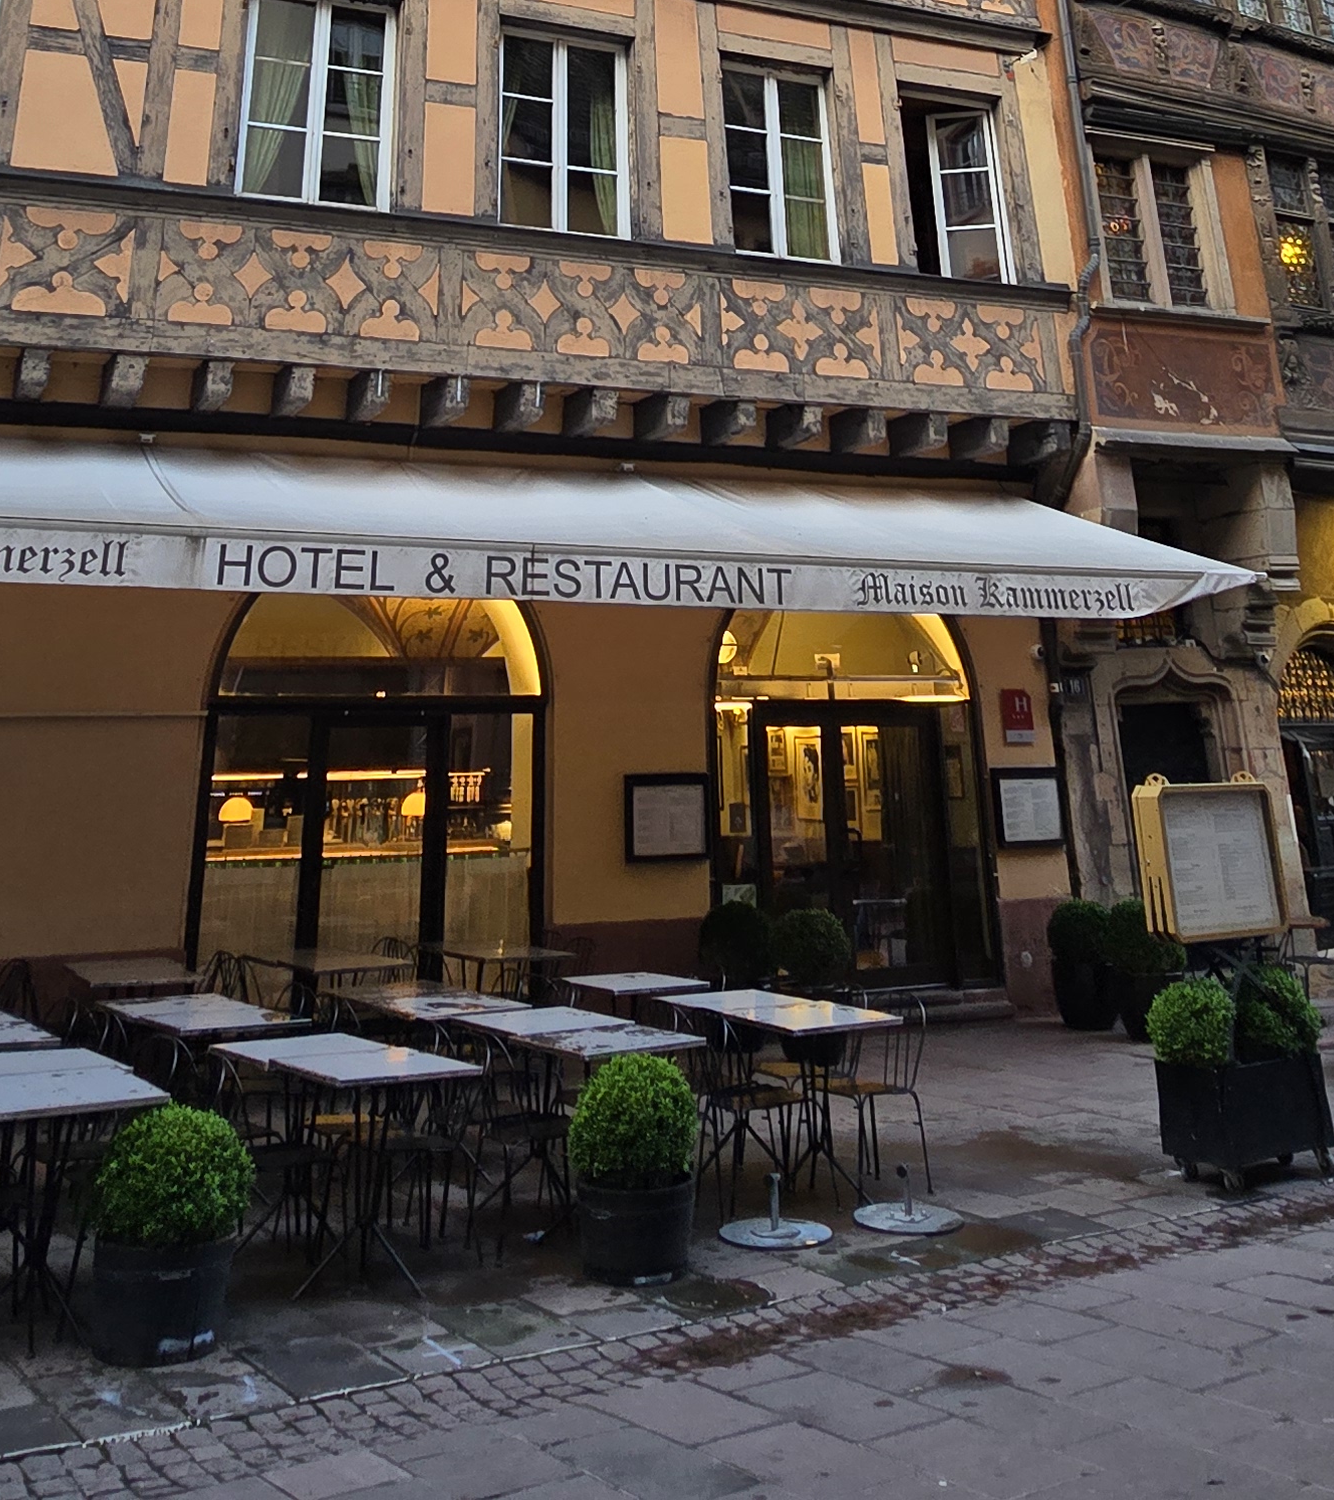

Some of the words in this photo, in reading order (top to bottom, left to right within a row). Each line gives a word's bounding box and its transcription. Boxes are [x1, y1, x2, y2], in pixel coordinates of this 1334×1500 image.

[217, 543, 395, 592] HOTEL
[425, 552, 456, 595] &
[485, 555, 793, 606] RESTAURANT
[856, 572, 968, 608] Maison
[975, 576, 1136, 617] Kammerzell
[1069, 679, 1082, 695] 16
[1014, 696, 1029, 713] H
